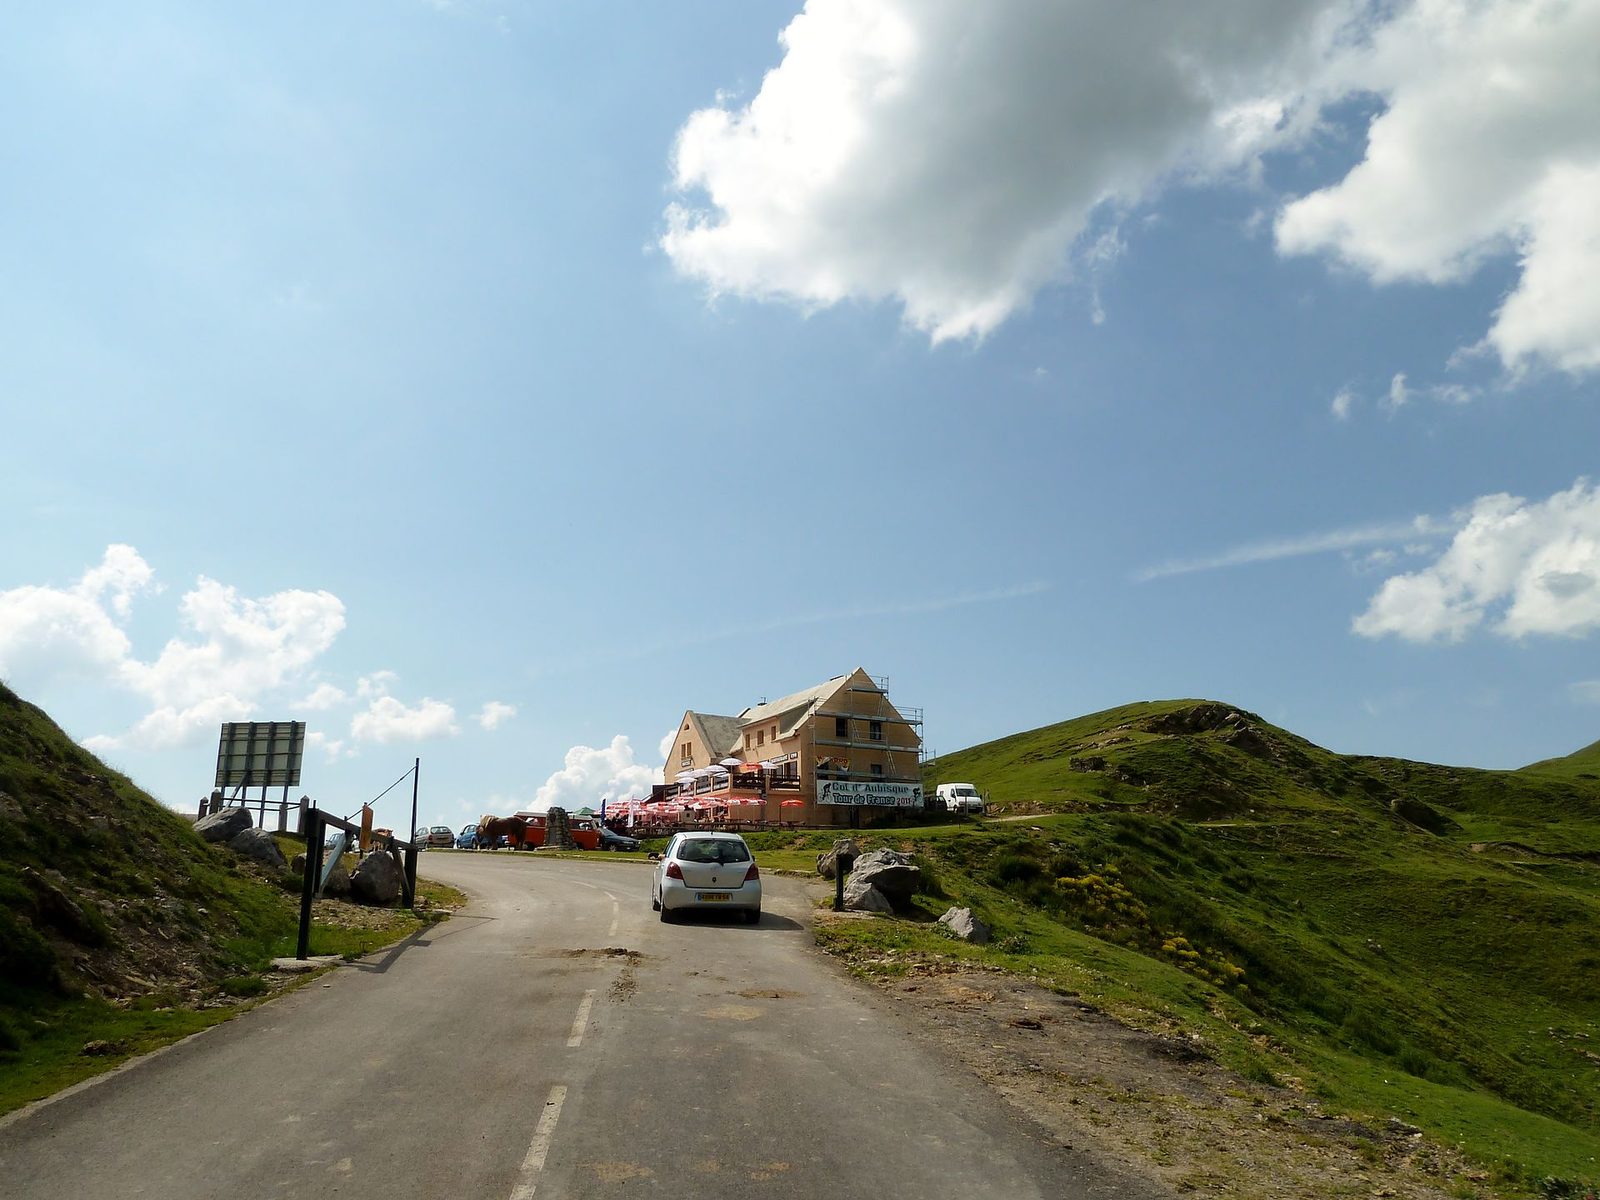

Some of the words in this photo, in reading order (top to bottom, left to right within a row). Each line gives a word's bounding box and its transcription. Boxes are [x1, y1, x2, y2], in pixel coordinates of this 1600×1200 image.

[833, 782, 848, 791] Col
[865, 784, 909, 794] Aubisque
[833, 793, 853, 804] Tour
[854, 794, 865, 804] de
[866, 794, 895, 805] France
[896, 797, 911, 806] 2011
